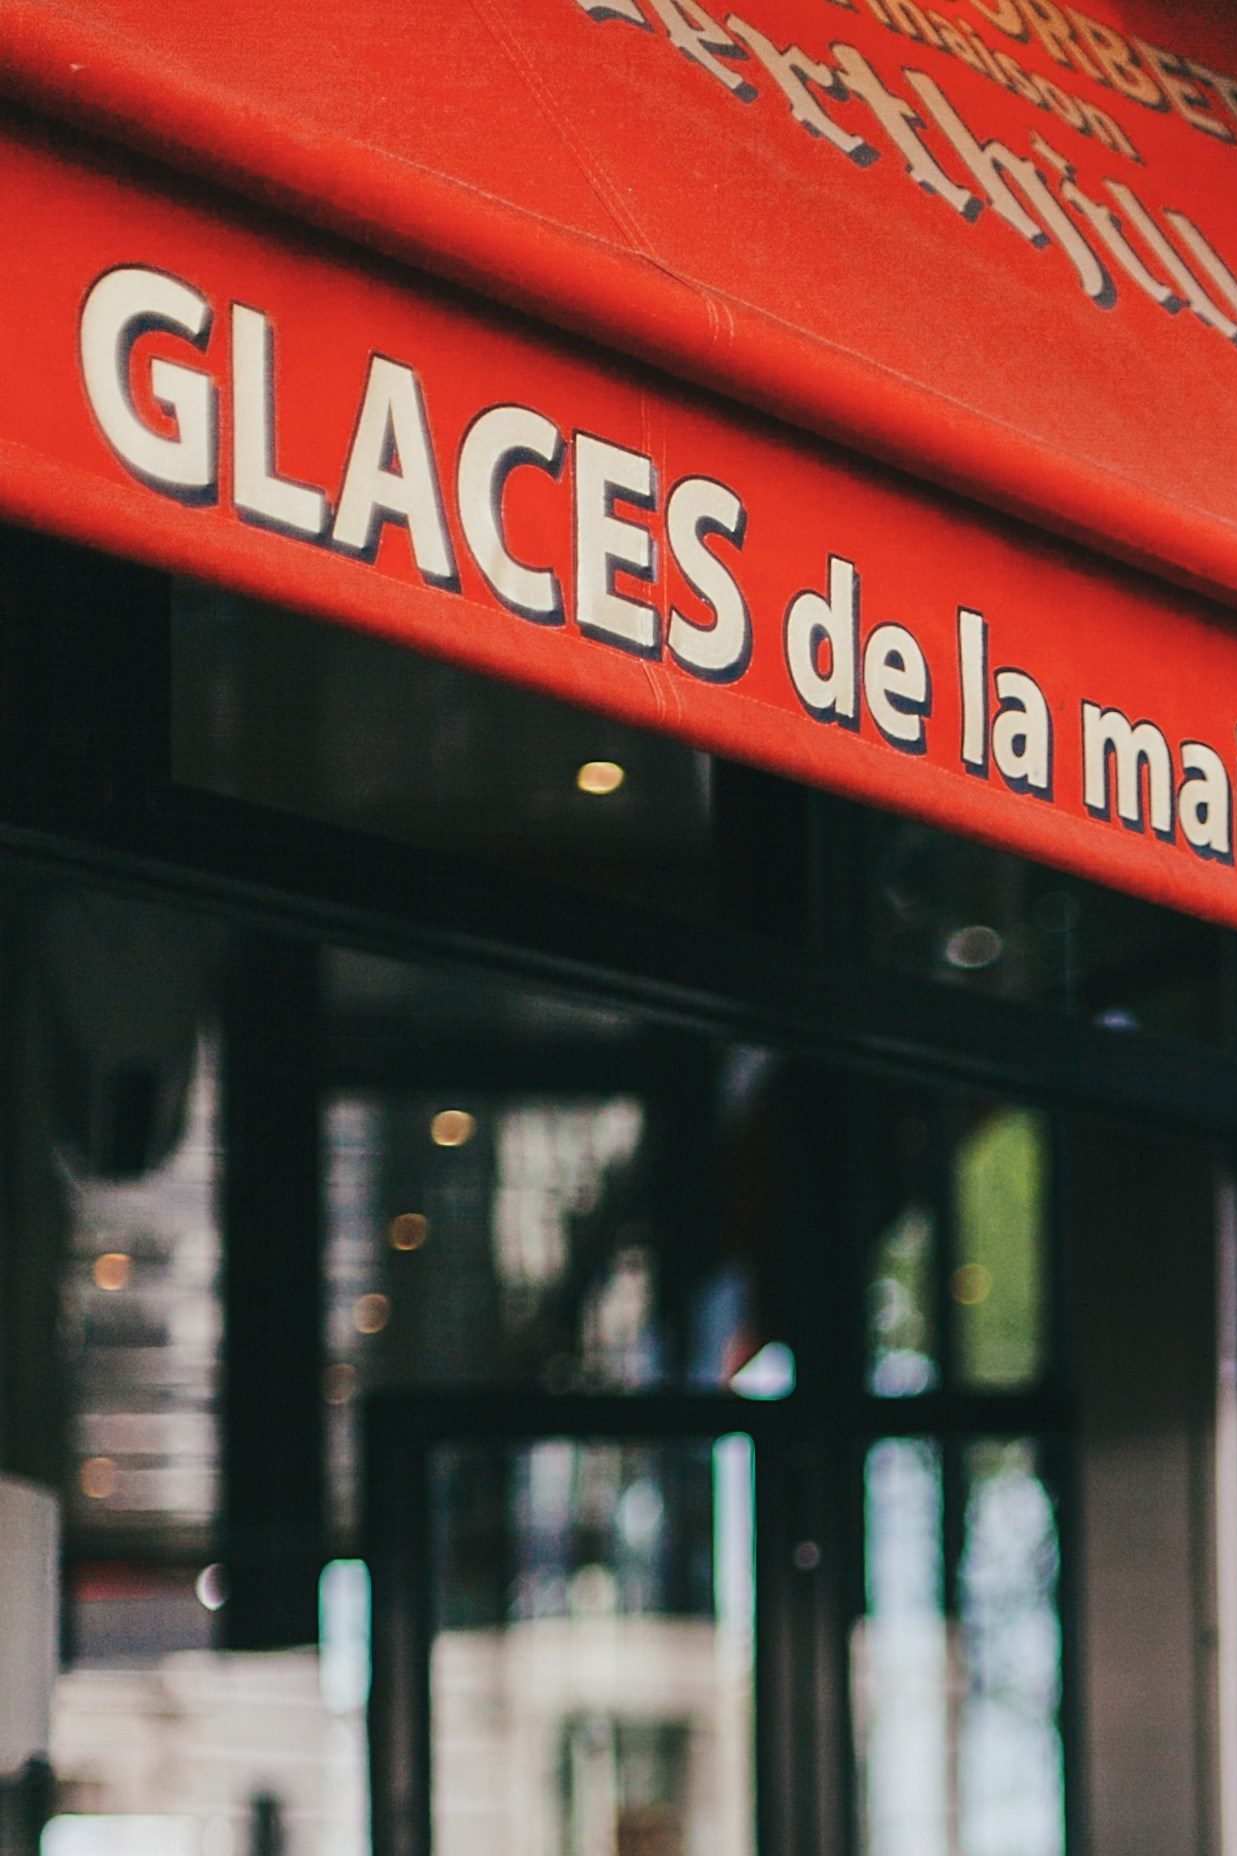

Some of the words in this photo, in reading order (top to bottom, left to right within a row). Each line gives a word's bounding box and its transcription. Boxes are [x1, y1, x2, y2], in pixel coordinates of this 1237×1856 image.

[78, 263, 753, 685] GLACES
[784, 554, 931, 755] de
[957, 605, 1053, 801] la
